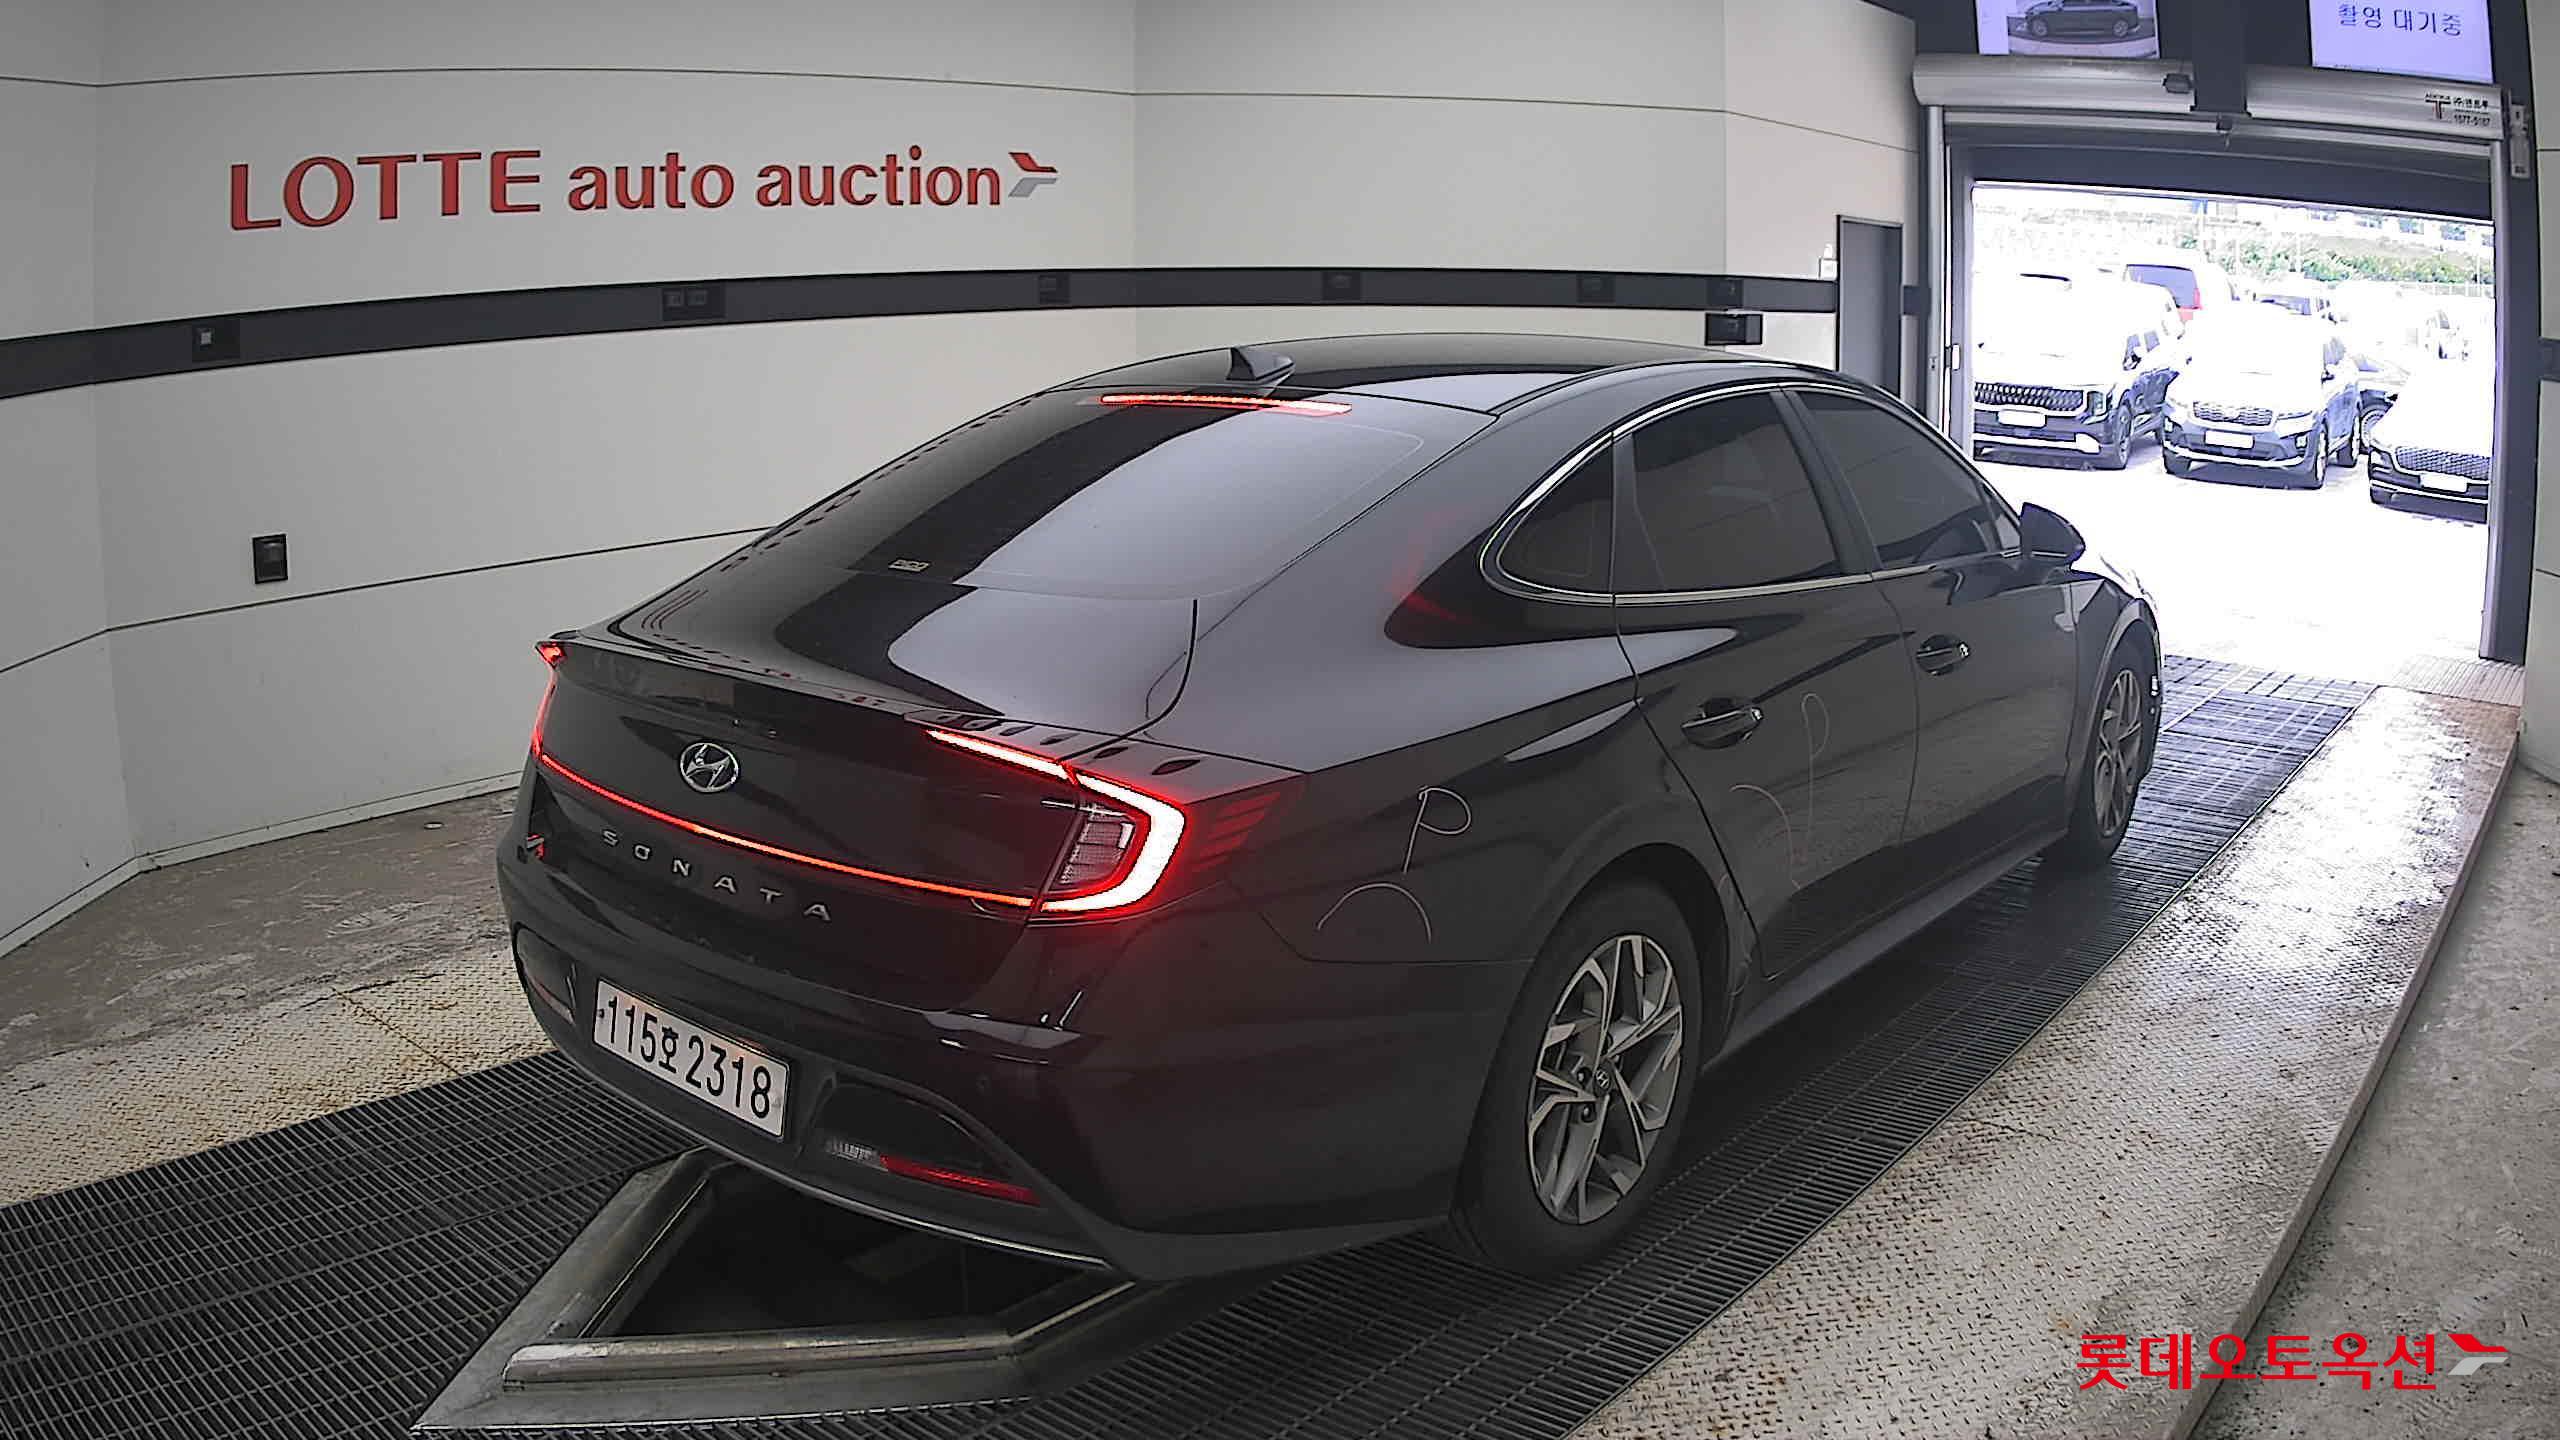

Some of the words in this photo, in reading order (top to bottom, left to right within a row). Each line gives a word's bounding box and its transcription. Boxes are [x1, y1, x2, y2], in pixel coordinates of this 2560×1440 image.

[2338, 3, 2382, 30] 촬영
[2393, 9, 2462, 37] 대기중
[229, 149, 542, 231] LOTTE
[567, 151, 734, 210] auto
[755, 144, 1002, 207] auction
[602, 829, 832, 921] SONATA
[607, 995, 679, 1074] 115호
[685, 1034, 772, 1119] 2318
